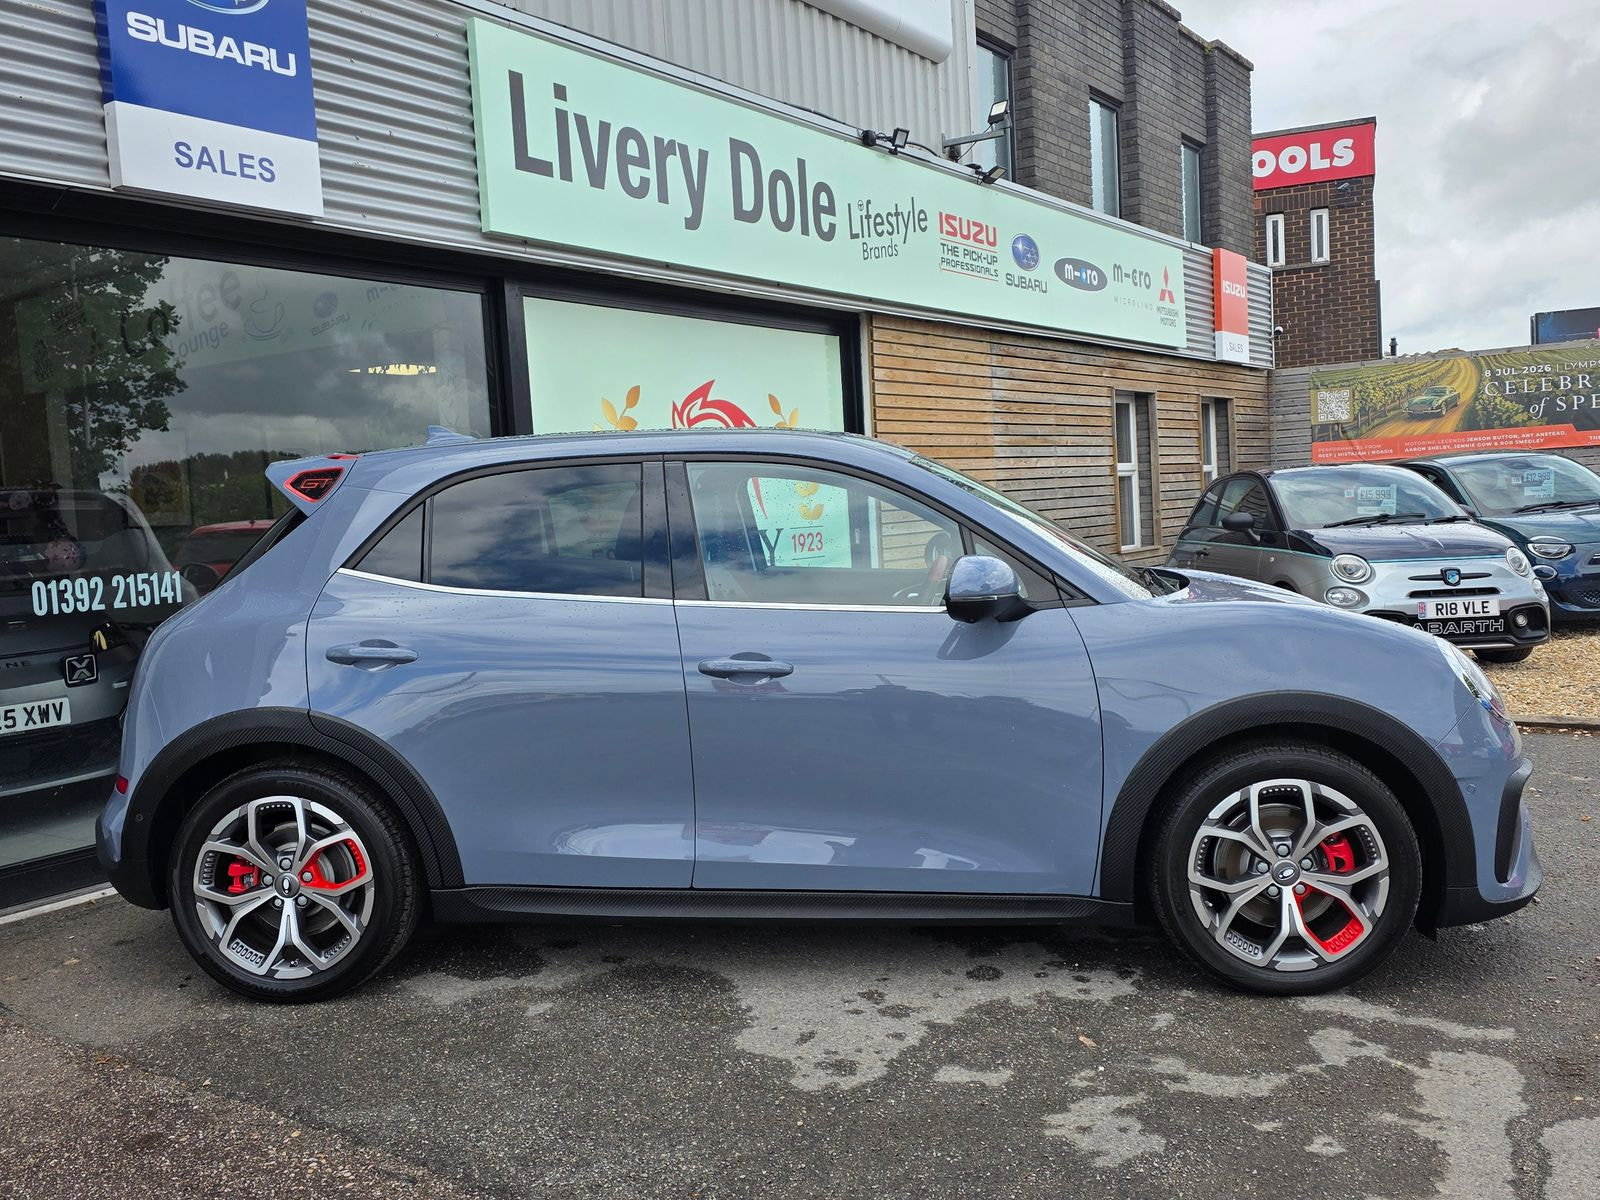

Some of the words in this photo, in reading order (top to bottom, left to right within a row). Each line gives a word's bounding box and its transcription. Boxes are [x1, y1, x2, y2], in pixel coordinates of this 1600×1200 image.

[126, 11, 297, 77] SUBARU
[174, 141, 276, 183] SALES
[508, 69, 709, 230] Livery
[729, 137, 836, 242] Dole
[1252, 138, 1355, 178] OOLS
[847, 196, 928, 245] Lifestyle
[938, 211, 997, 247] ISUZU
[862, 238, 899, 261] Brands
[940, 242, 959, 258] THE
[963, 248, 998, 266] PICK-UP
[940, 257, 999, 278] PROFESSIONALS
[1005, 273, 1048, 293] SUBARU
[1222, 279, 1246, 298] ISUZU
[1156, 305, 1180, 318] MITSUBISHI
[1160, 317, 1177, 328] MOTORS
[1228, 341, 1244, 353] SALES
[1484, 369, 1491, 377] 8
[1495, 367, 1518, 376] JUL
[1522, 364, 1552, 374] 2026
[1564, 359, 1600, 370] LYMP
[1485, 373, 1600, 396] CELEBR
[1529, 396, 1550, 419] of
[300, 478, 333, 489] GT
[791, 531, 824, 553] 1923
[31, 576, 106, 616] 01392
[111, 570, 183, 609] 215141
[1435, 602, 1458, 616] R18
[1462, 600, 1490, 615] VLE
[0, 660, 32, 669] NE
[0, 708, 17, 730] 5
[23, 701, 64, 726] XWV
